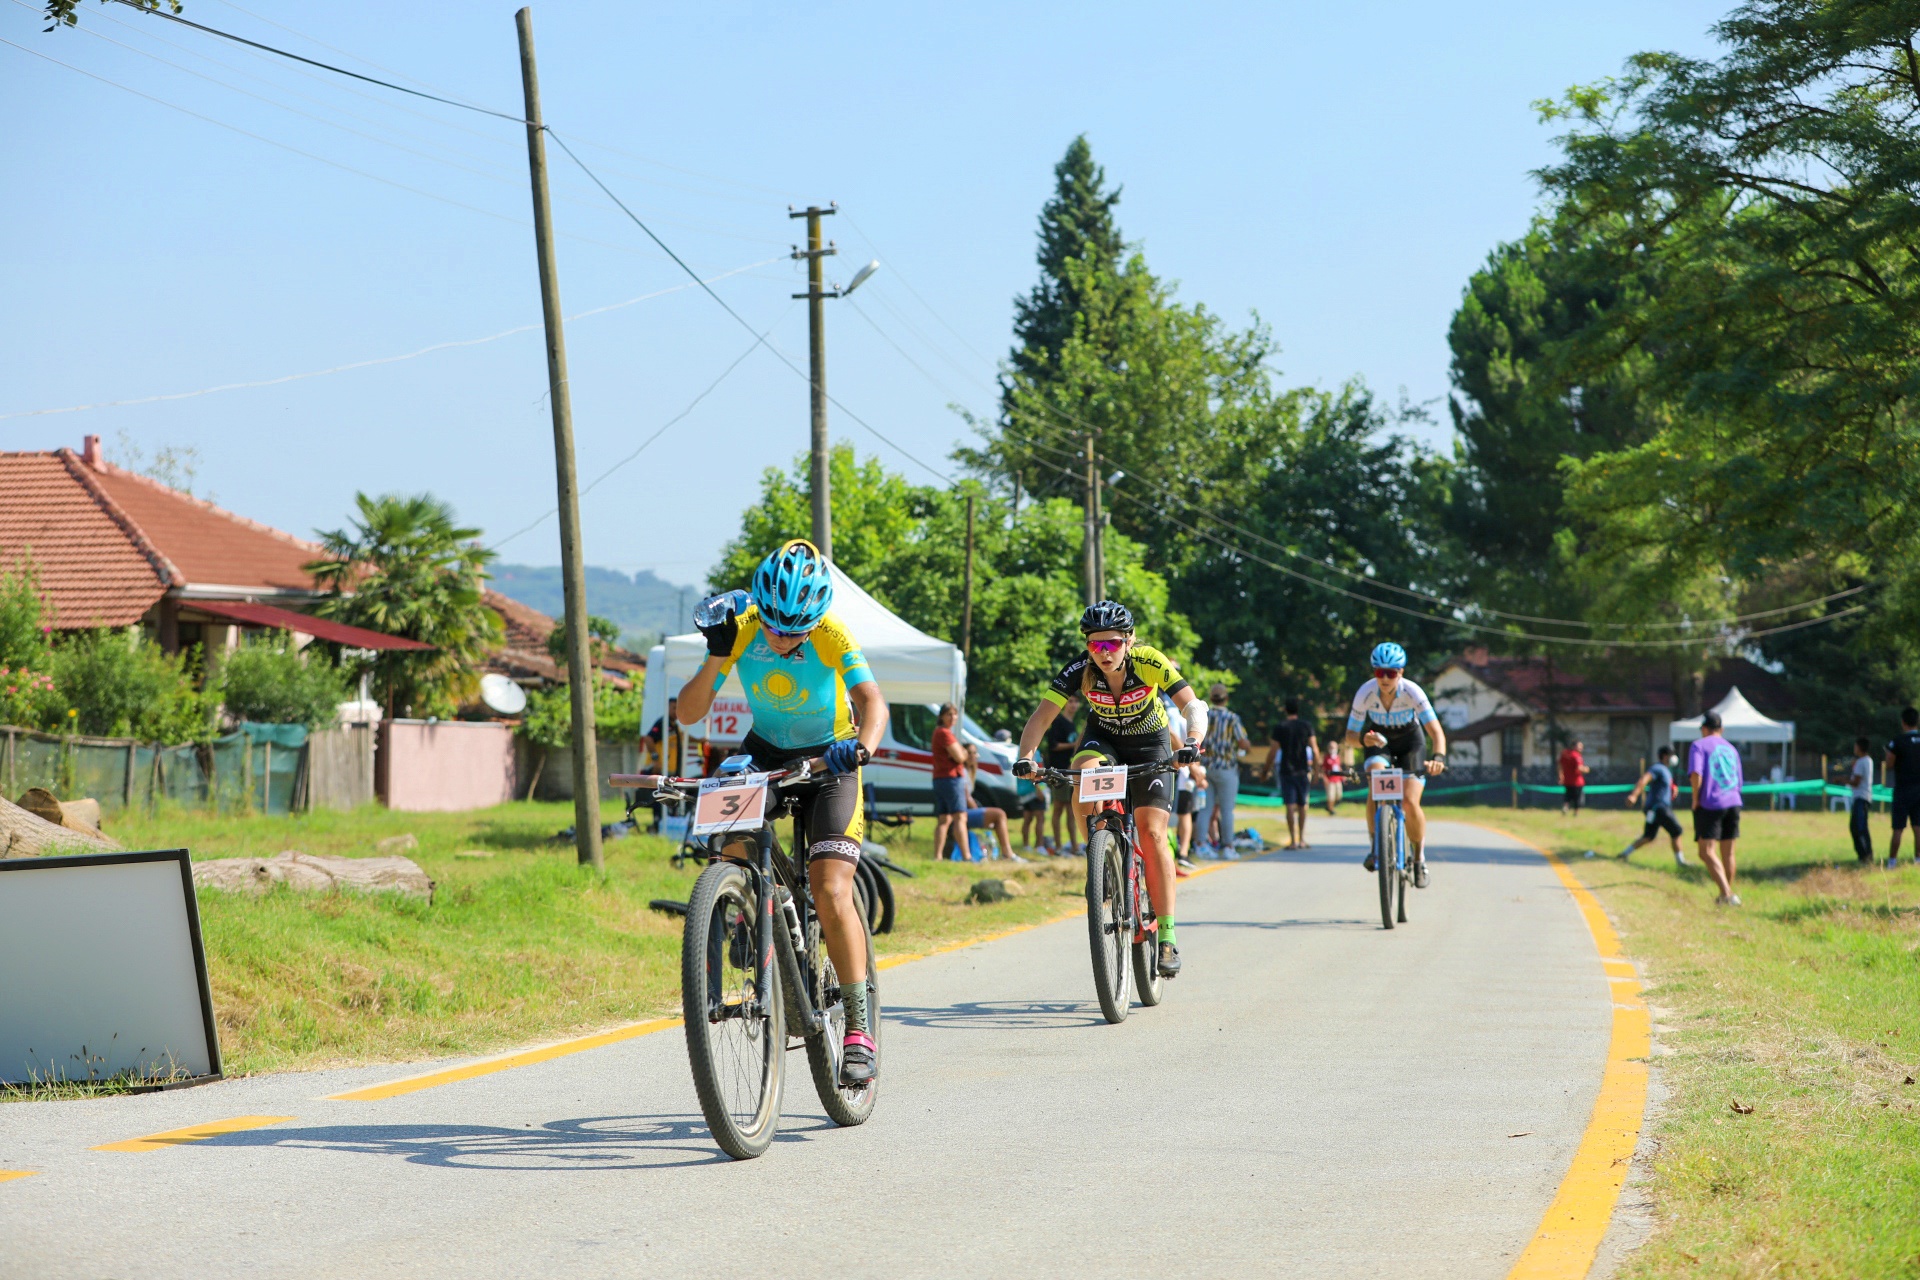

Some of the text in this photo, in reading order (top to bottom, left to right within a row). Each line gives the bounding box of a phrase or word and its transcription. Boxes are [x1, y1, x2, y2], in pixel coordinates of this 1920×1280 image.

[746, 652, 775, 662] HYUNDAI
[1131, 656, 1162, 669] HEAD
[1088, 689, 1146, 704] HEAD
[1092, 777, 1114, 791] 13
[1380, 780, 1395, 791] 14
[720, 795, 740, 815] 3
